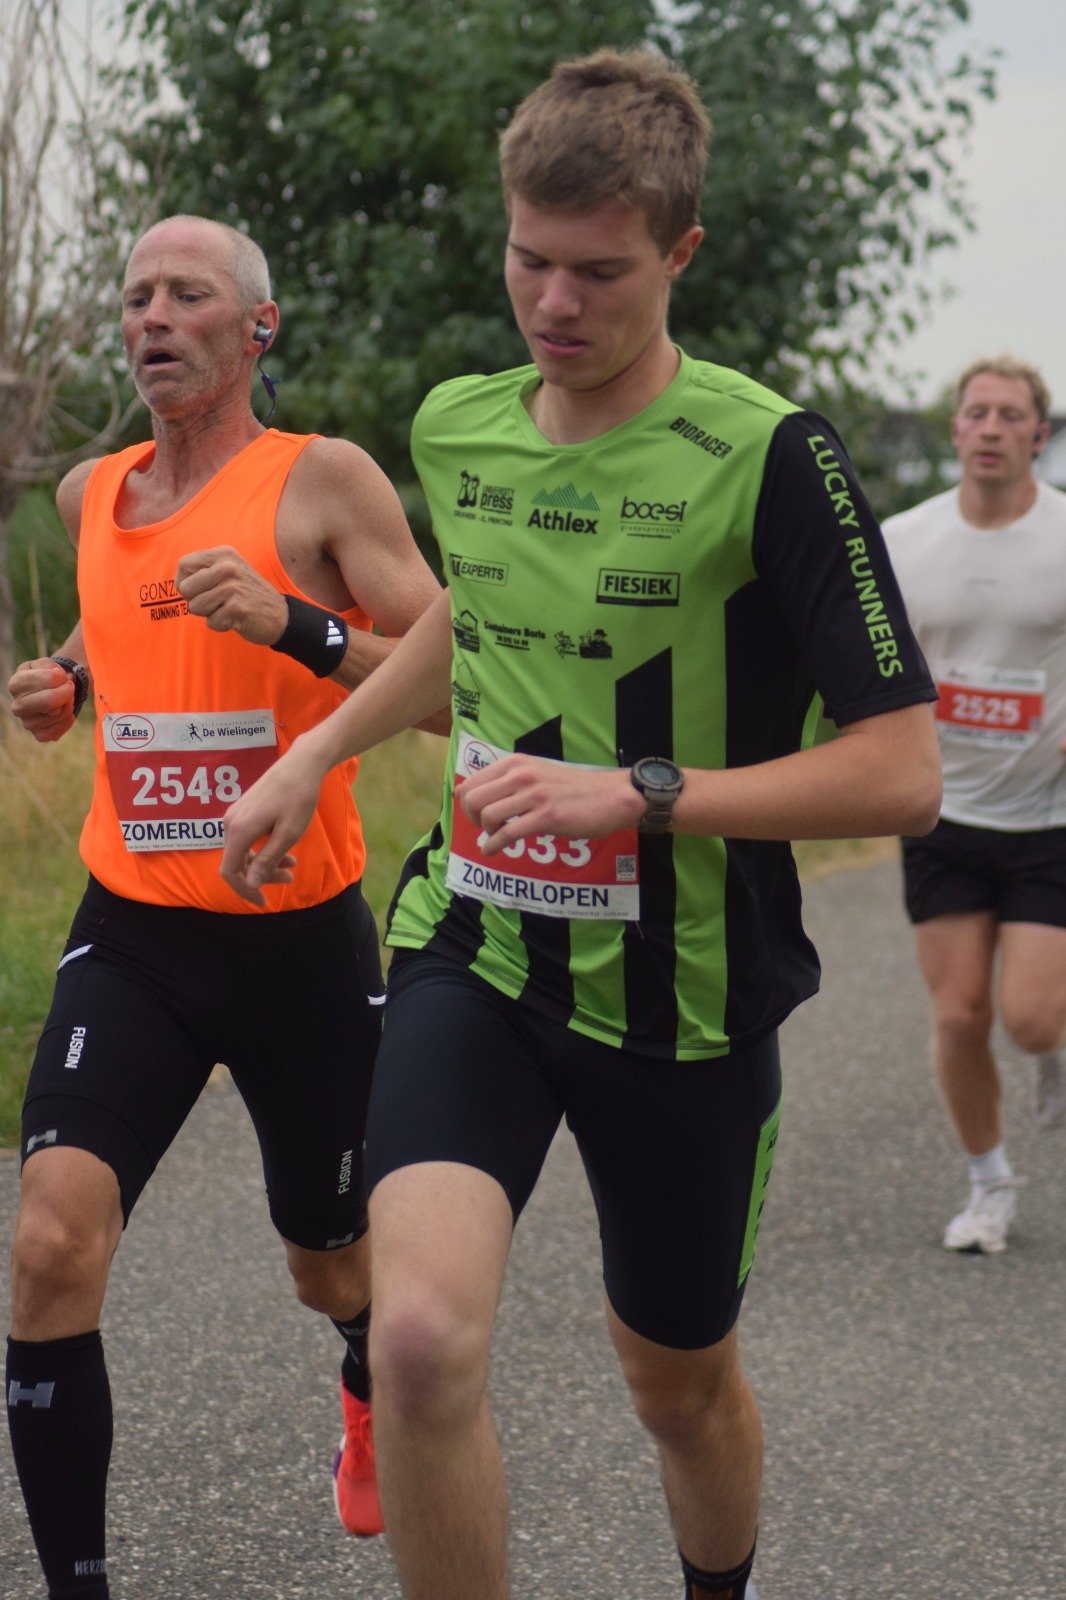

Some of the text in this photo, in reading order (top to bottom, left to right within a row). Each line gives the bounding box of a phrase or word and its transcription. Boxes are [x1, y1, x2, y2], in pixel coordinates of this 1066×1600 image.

[669, 416, 733, 460] BIORACER
[480, 493, 514, 510] press
[527, 508, 599, 535] Athlex
[461, 561, 505, 580] EXPERTS
[806, 434, 904, 678] LUCKY RUNNERS
[140, 580, 178, 601] GONZ
[604, 574, 673, 596] FIESIEK
[150, 604, 180, 621] RUNNING
[952, 693, 1021, 726] 2525
[203, 726, 266, 737] De Wielingen
[131, 765, 242, 806] 2548
[462, 862, 609, 907] ZOMERLOPEN
[64, 1026, 86, 1069] FUSION
[338, 1149, 353, 1195] FUSION
